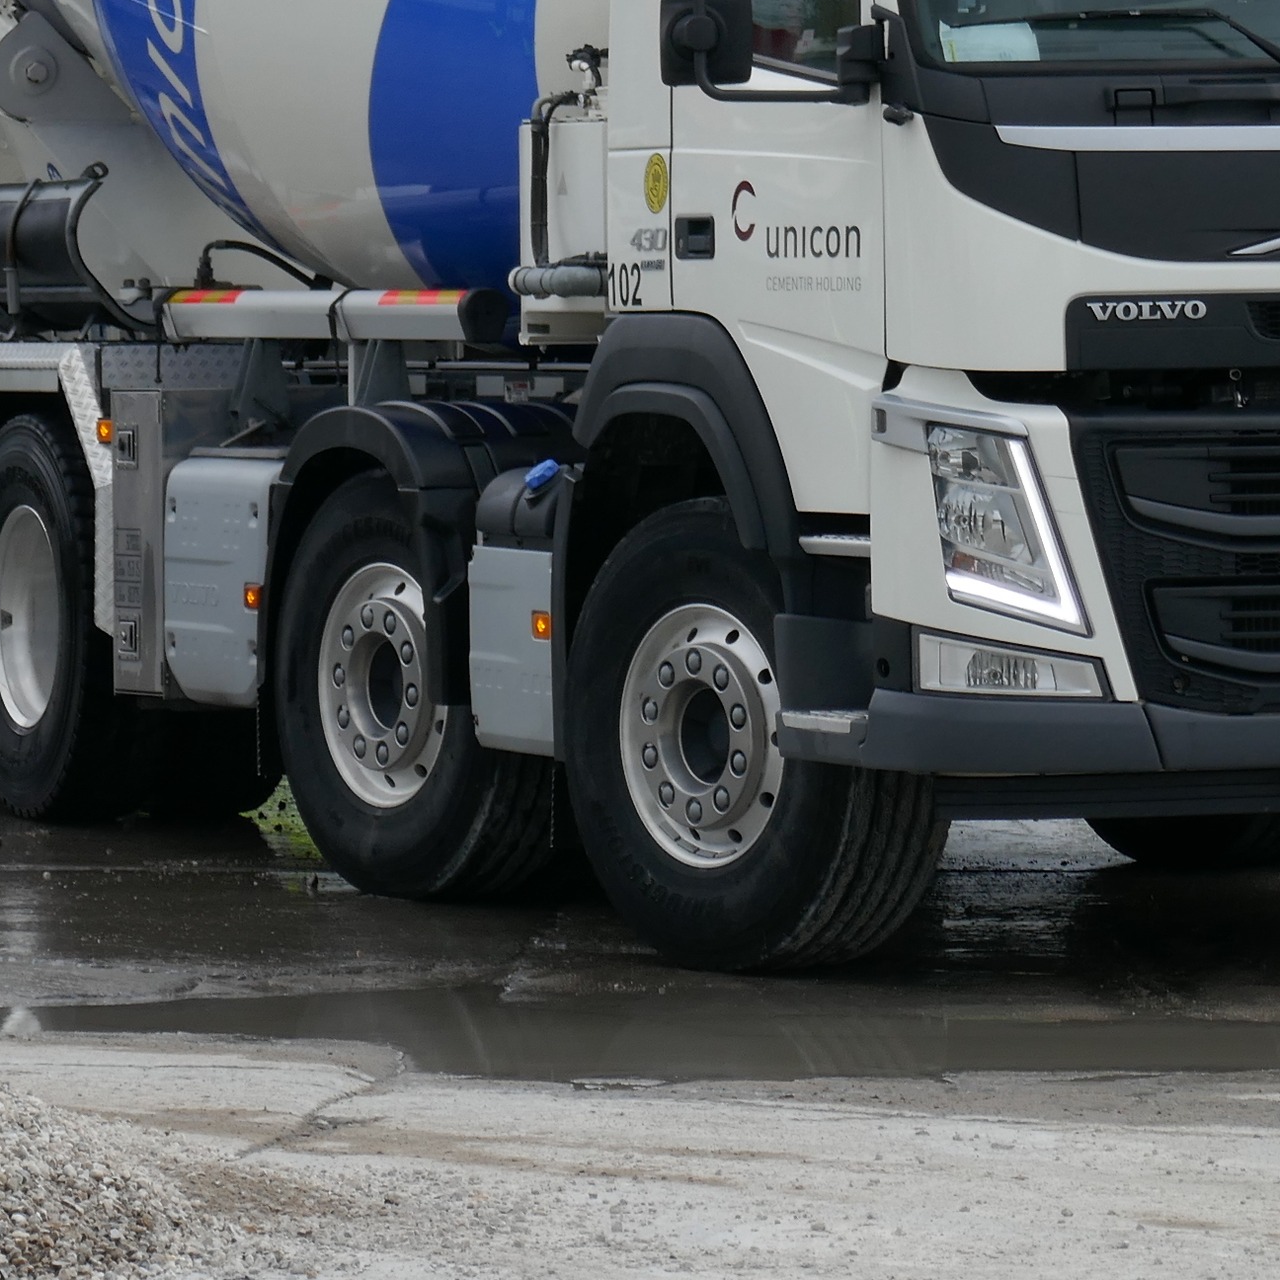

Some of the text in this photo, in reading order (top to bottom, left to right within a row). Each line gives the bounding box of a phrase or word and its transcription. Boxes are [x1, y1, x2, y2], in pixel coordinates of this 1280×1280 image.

[630, 228, 667, 252] 430
[766, 224, 861, 259] unicon
[608, 263, 642, 307] 102
[766, 275, 862, 292] CEMENTIR HOLDING
[1086, 300, 1207, 321] VOLVO
